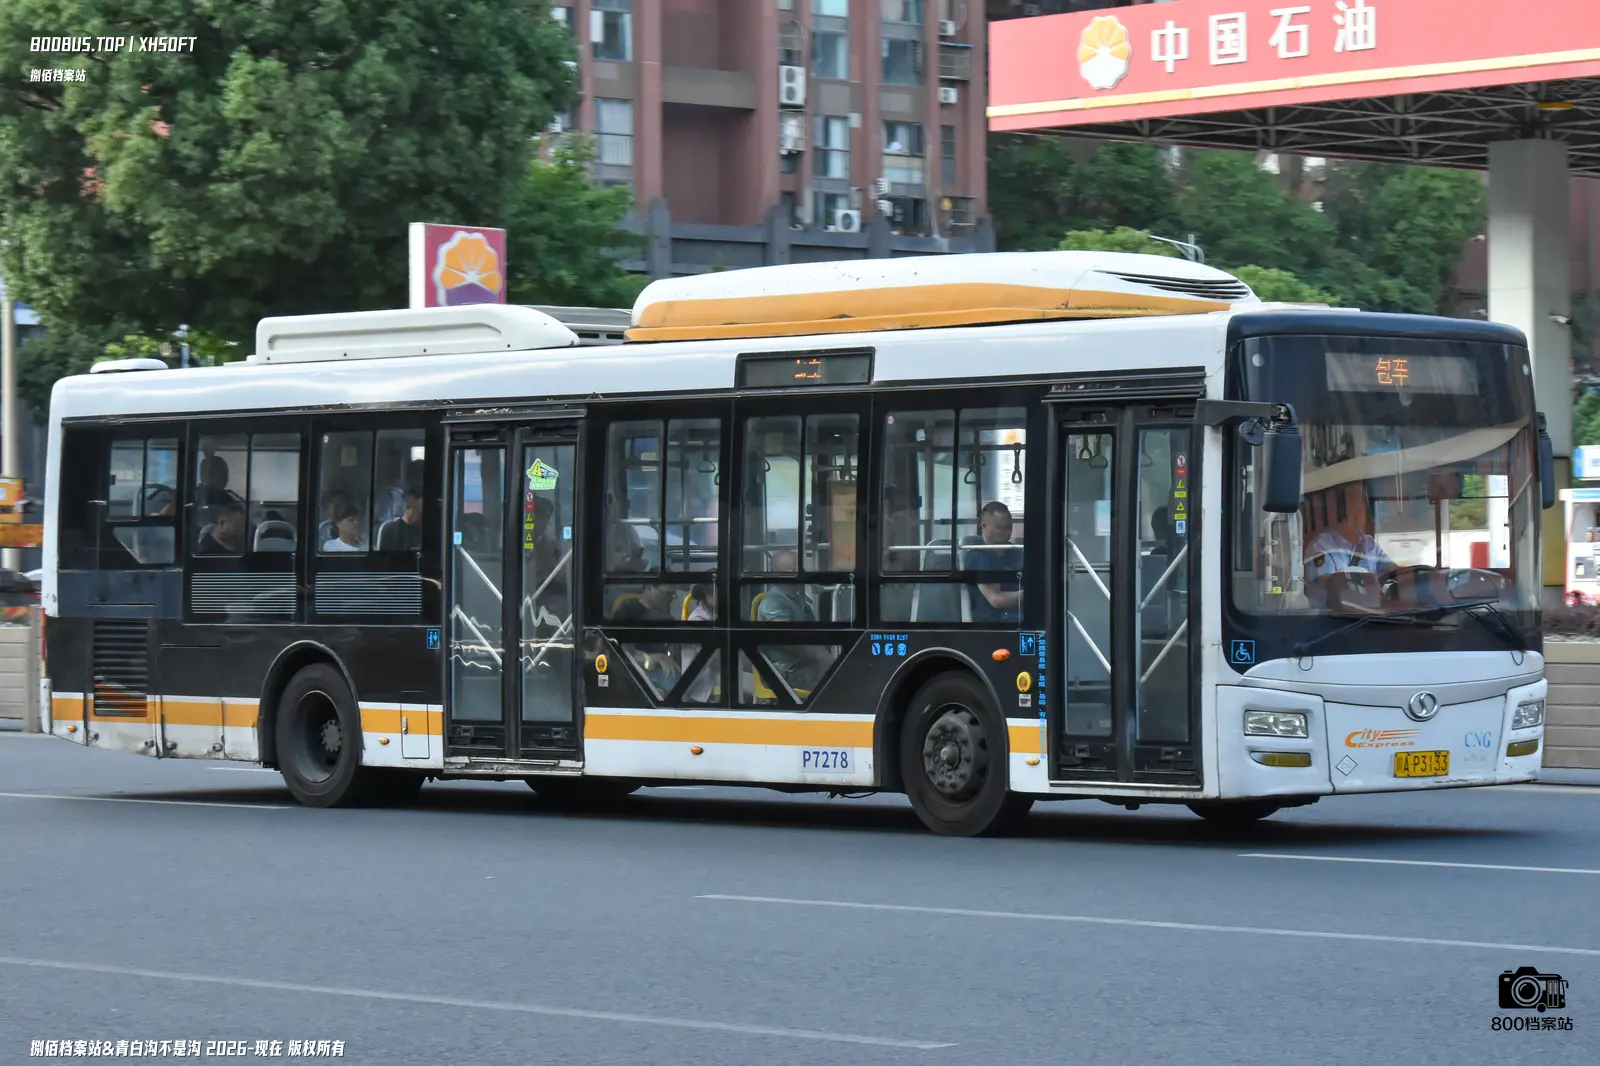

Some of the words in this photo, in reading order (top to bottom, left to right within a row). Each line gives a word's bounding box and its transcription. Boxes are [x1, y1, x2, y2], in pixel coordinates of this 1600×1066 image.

[1151, 0, 1377, 73] 中国石油
[1345, 728, 1382, 748] City
[1465, 731, 1491, 748] CNG
[802, 750, 849, 769] P7278
